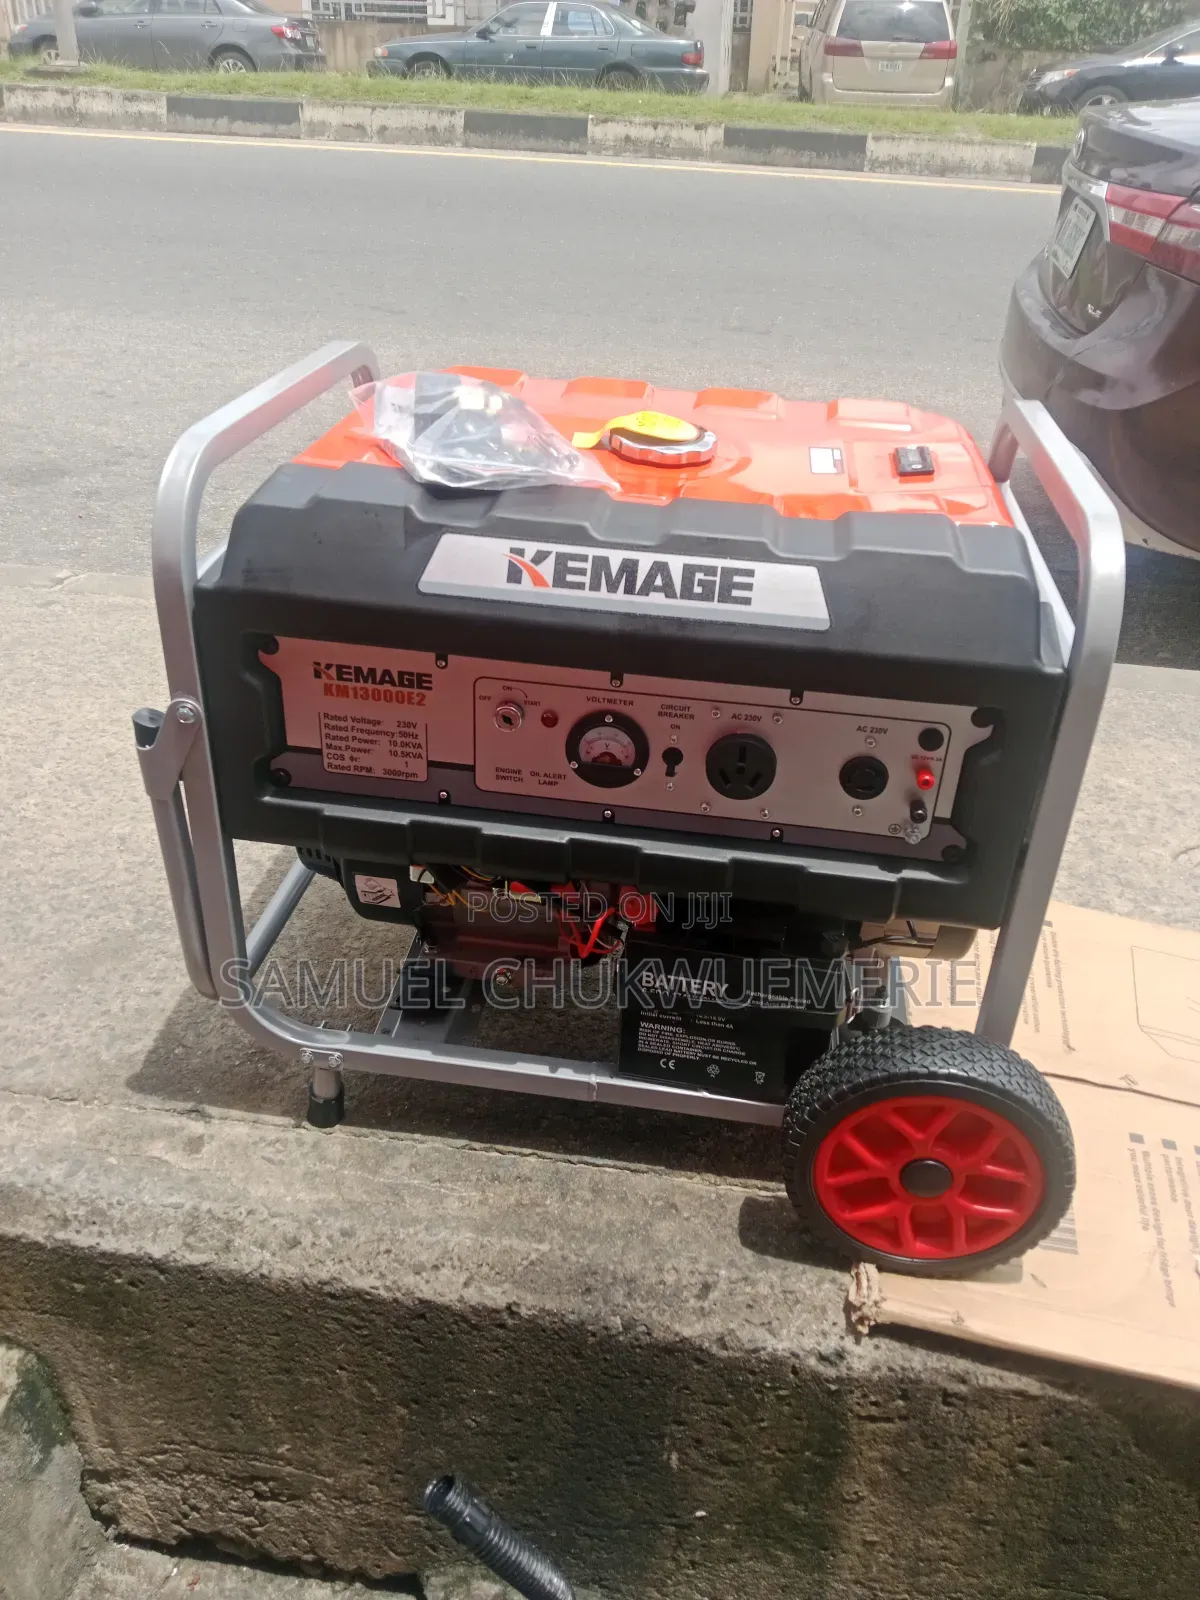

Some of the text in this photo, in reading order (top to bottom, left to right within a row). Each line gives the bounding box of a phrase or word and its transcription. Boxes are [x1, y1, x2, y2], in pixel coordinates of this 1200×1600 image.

[502, 546, 756, 606] KEMAGE
[312, 661, 433, 691] KEMAGE
[323, 683, 427, 706] KM13000E2
[586, 695, 635, 707] VOLTMETER
[660, 703, 691, 713] CIRCUIT
[323, 712, 348, 723] Rated
[396, 720, 418, 730] 230V
[657, 711, 695, 721] BREAKER
[731, 713, 762, 722] AC 230V
[324, 723, 349, 733] Rated
[856, 725, 889, 735] AC 230V
[325, 733, 423, 751] Rated Power: 10.0KVA
[326, 752, 345, 762] COS
[388, 749, 424, 761] 10.5KVA
[327, 762, 419, 780] Rated RPM: 3000rpm
[495, 766, 523, 776] ENGINE
[529, 770, 543, 778] OIL
[495, 774, 524, 783] SWITCH
[538, 779, 559, 787] LAMP
[642, 971, 729, 998] BATTERY
[640, 1020, 686, 1034] WARNING:
